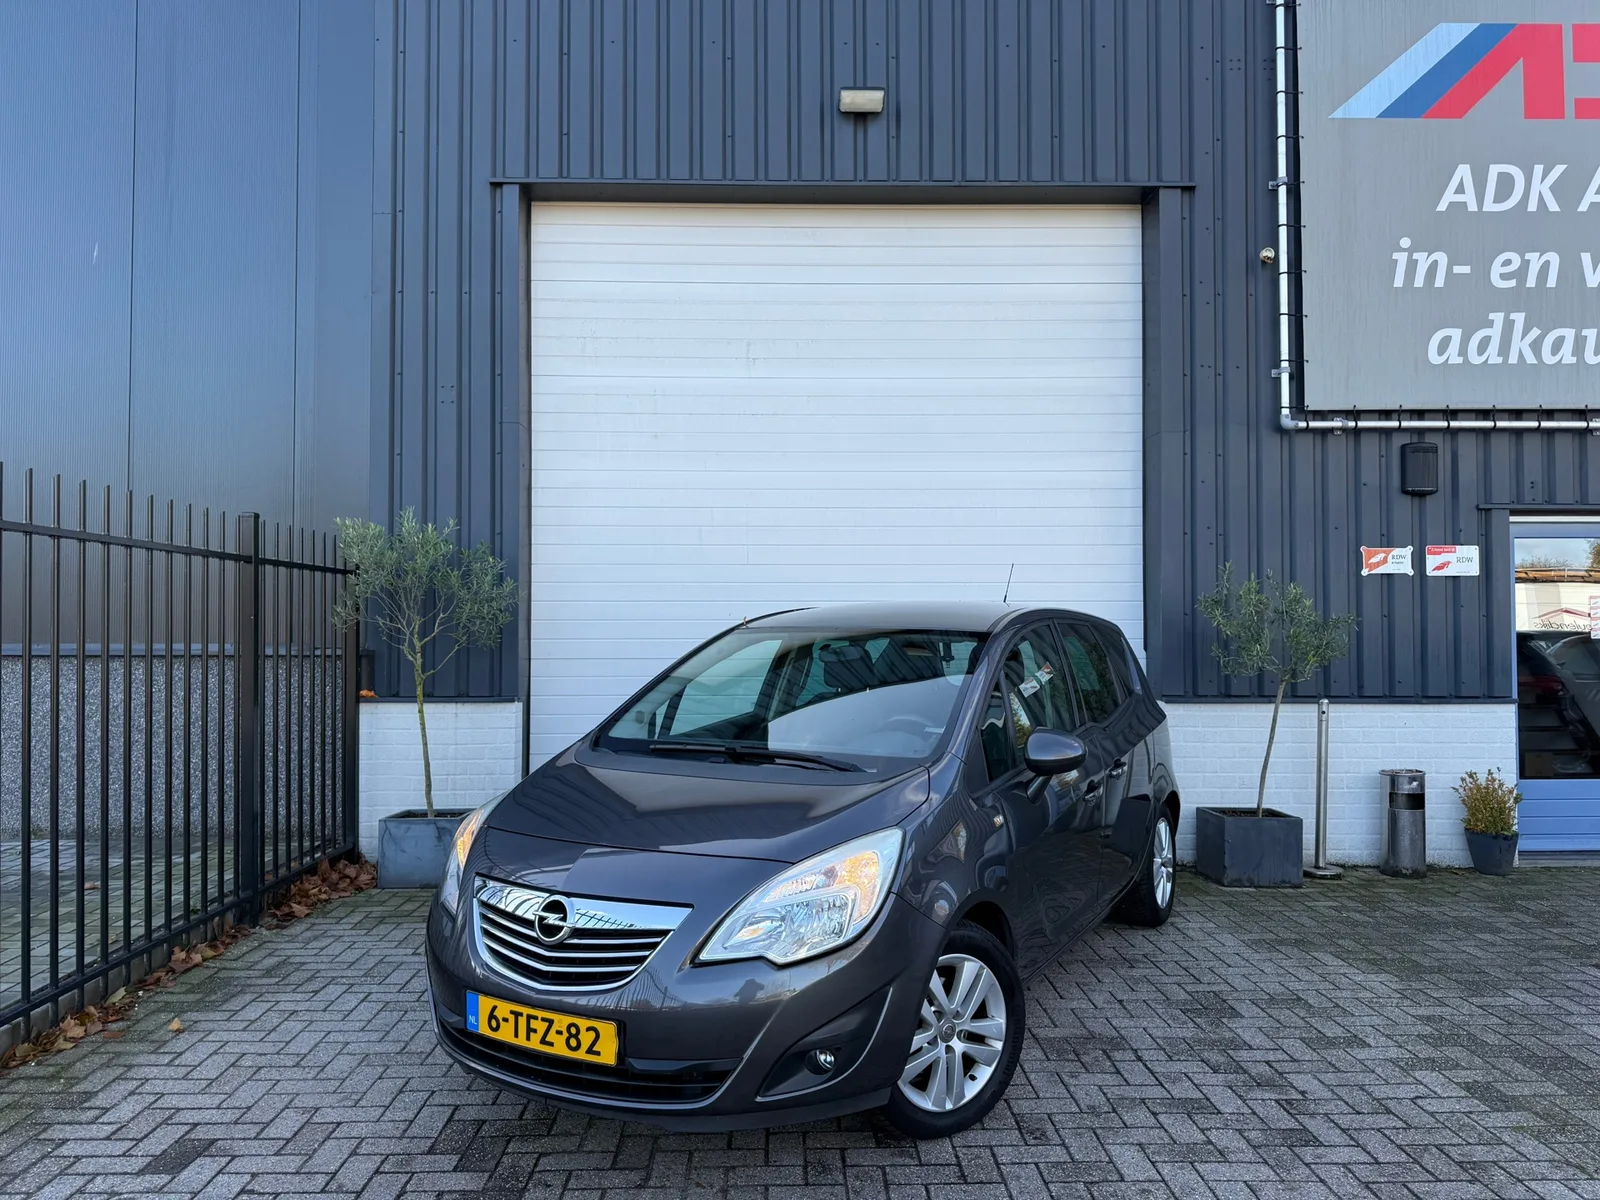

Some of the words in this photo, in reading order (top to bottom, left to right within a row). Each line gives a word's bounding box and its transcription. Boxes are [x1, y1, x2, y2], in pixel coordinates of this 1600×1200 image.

[1436, 164, 1568, 212] ADK
[1391, 237, 1471, 288] in-
[1490, 252, 1560, 288] en
[1456, 556, 1474, 564] RDW
[468, 1014, 478, 1025] NL
[487, 1005, 602, 1057] 6-TFZ-82
